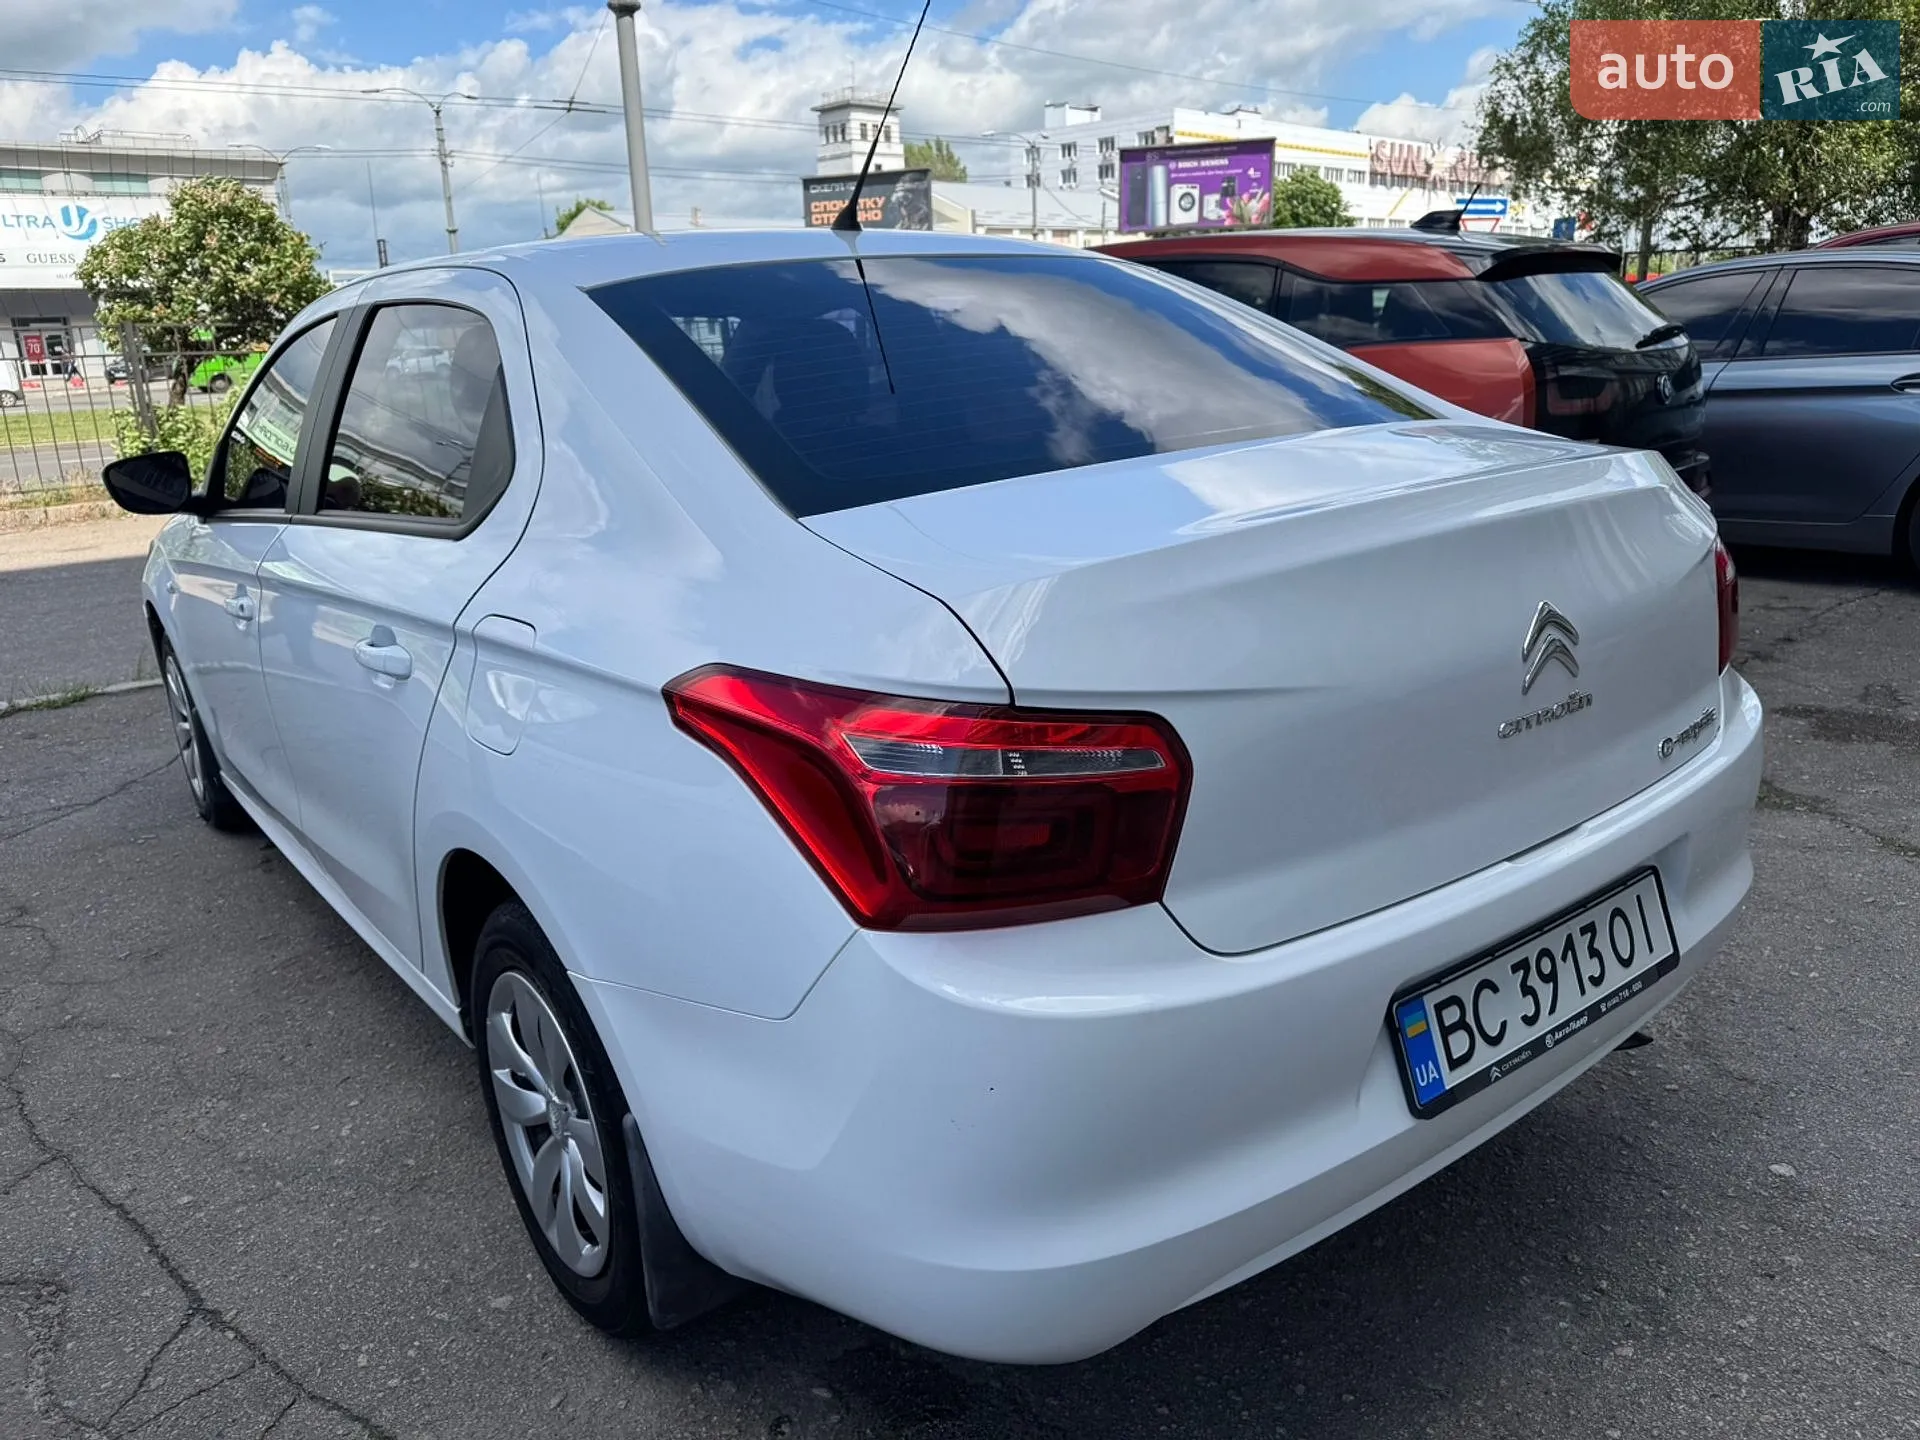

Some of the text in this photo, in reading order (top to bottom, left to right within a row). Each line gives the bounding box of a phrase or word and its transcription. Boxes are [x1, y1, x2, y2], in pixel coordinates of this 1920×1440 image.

[1372, 140, 1427, 177] SUN
[811, 196, 885, 212] СПОЧТКУ
[812, 209, 882, 225] СТРНО
[26, 253, 76, 264] GUESS
[1434, 979, 1508, 1072] BC
[1510, 920, 1606, 1027] 3913
[1415, 1060, 1439, 1087] UA
